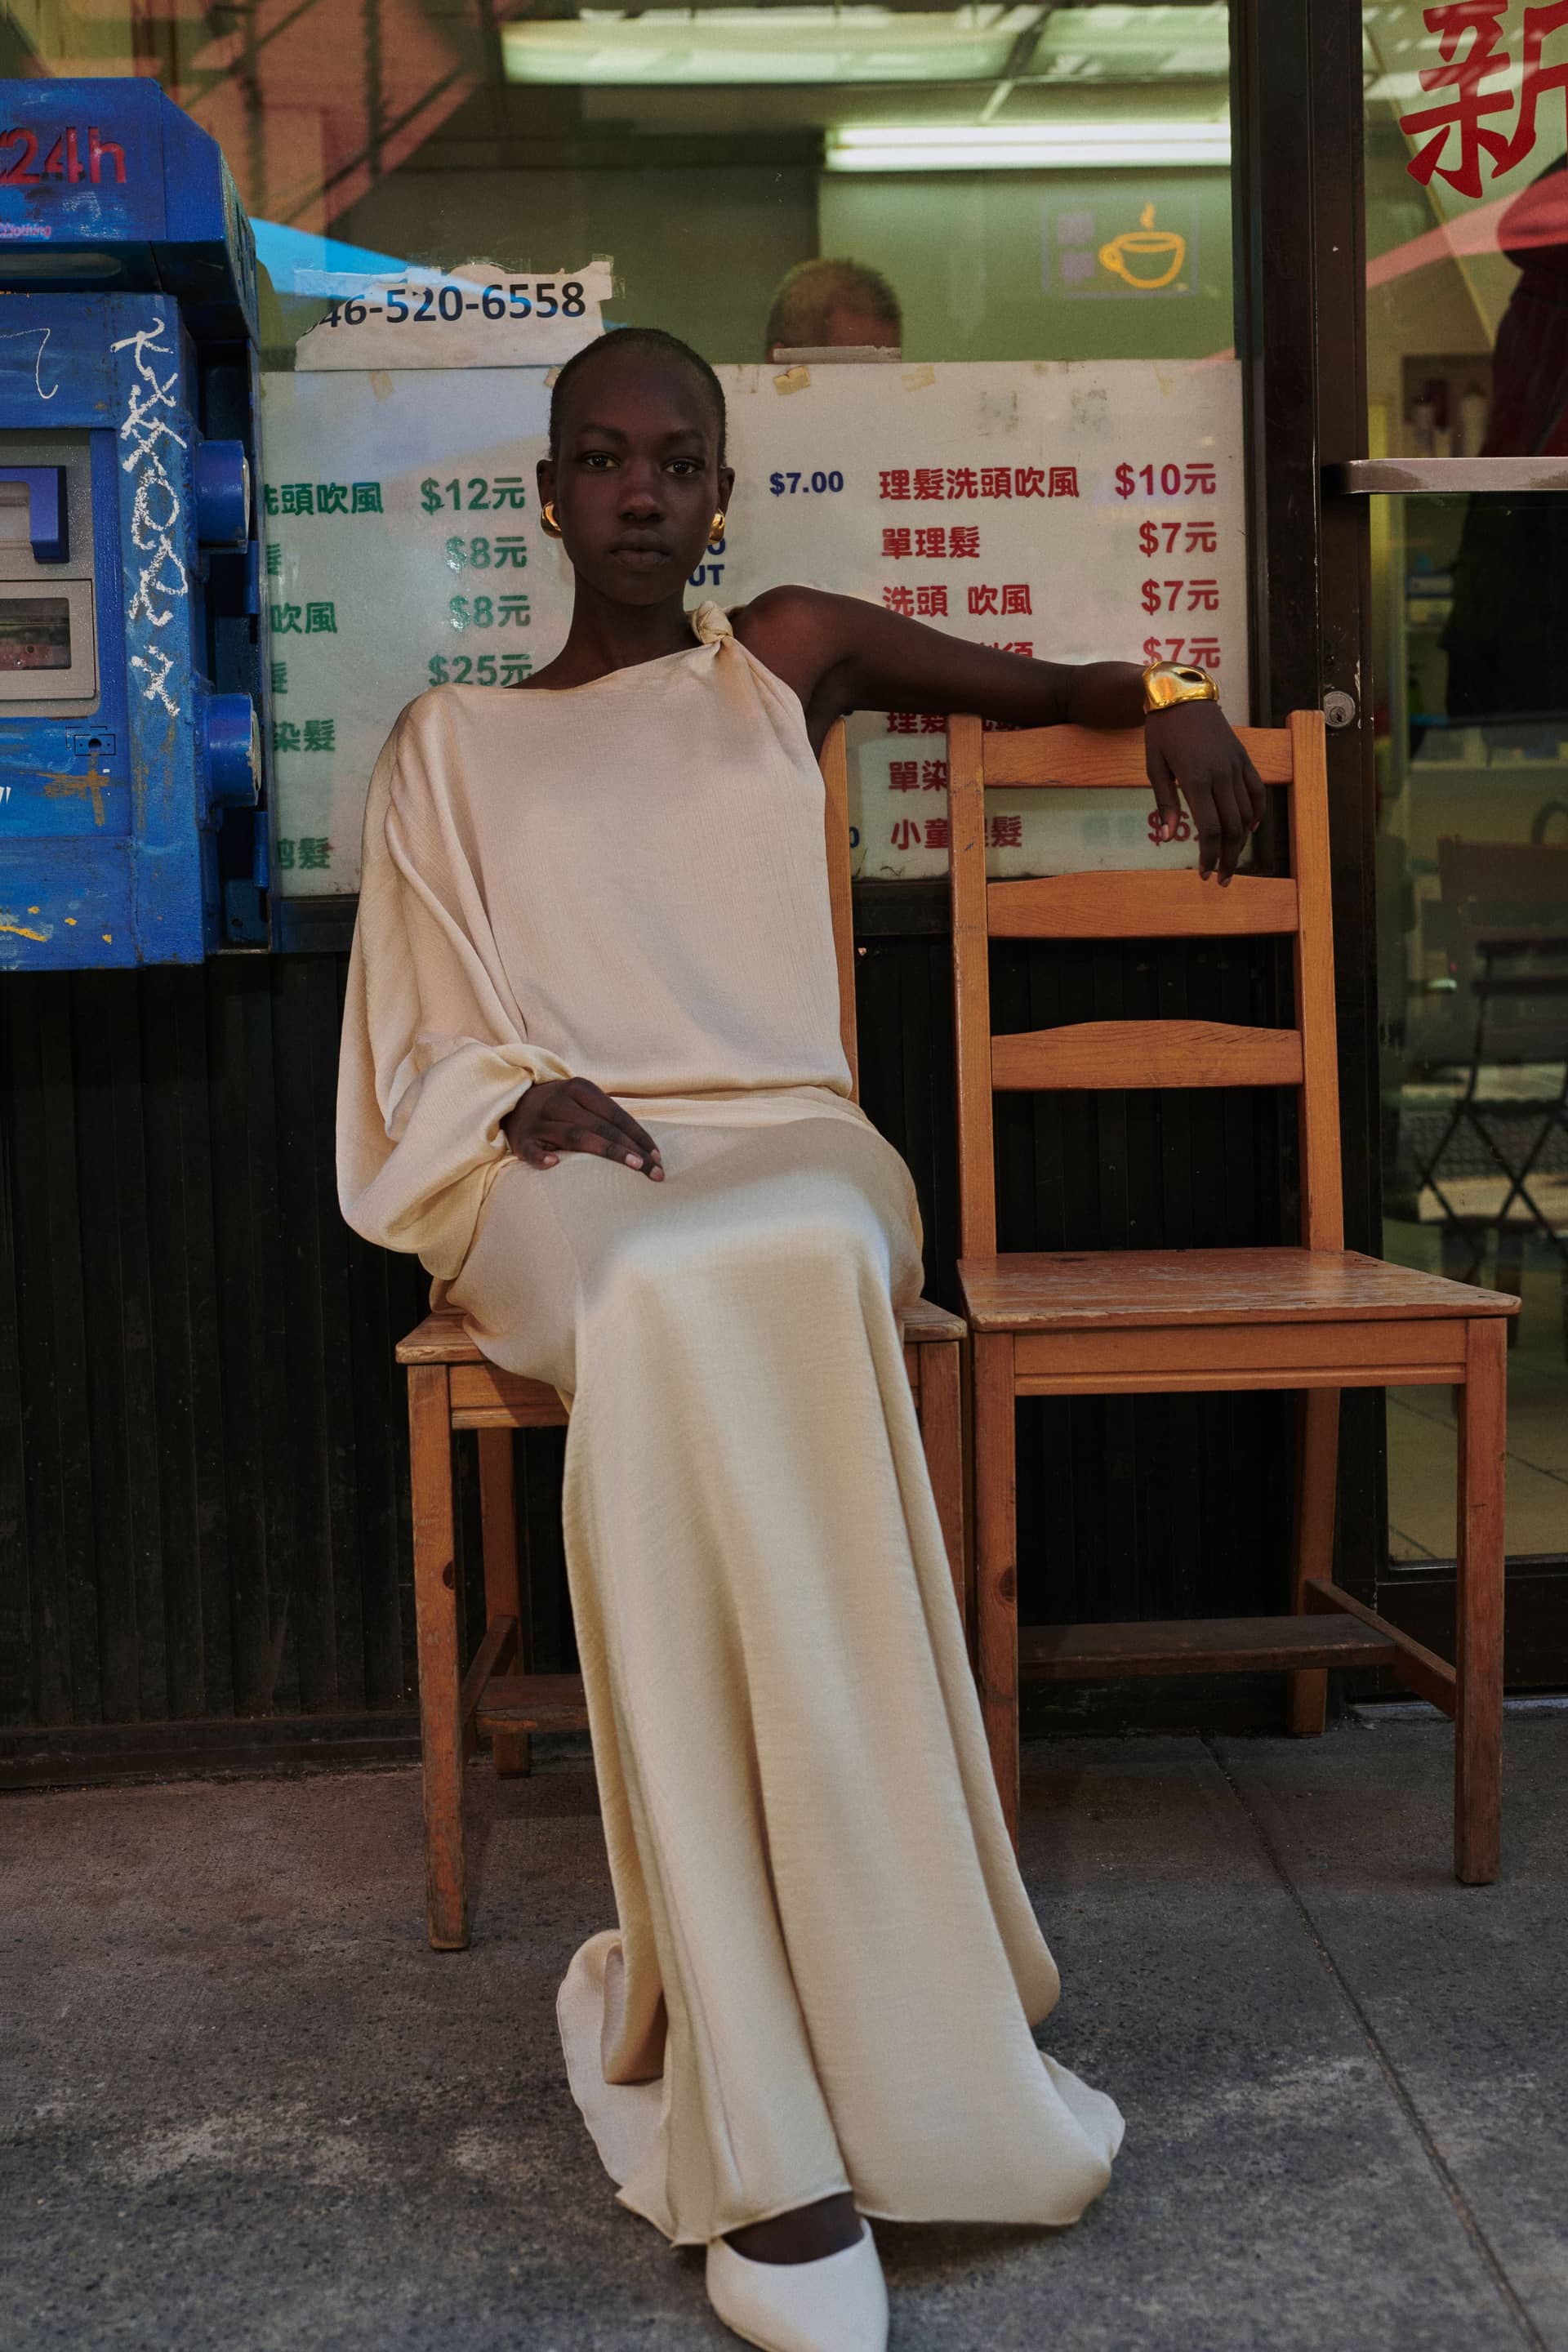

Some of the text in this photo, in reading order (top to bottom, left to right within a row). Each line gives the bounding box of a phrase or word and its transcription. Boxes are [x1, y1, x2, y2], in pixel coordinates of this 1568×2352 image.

[312, 283, 586, 330] 46-520-6558
[421, 477, 525, 515] $12元
[769, 470, 844, 497] $7.00
[879, 462, 1216, 501] 理髮洗頭吹風 $10元
[445, 536, 527, 574] $8元
[881, 520, 1217, 559] 單理髮 $7元
[450, 595, 531, 634] $8元
[882, 578, 1219, 617] 洗頭 吹風 $7元
[429, 653, 533, 687] $25元
[890, 815, 1022, 850] 小童髮
